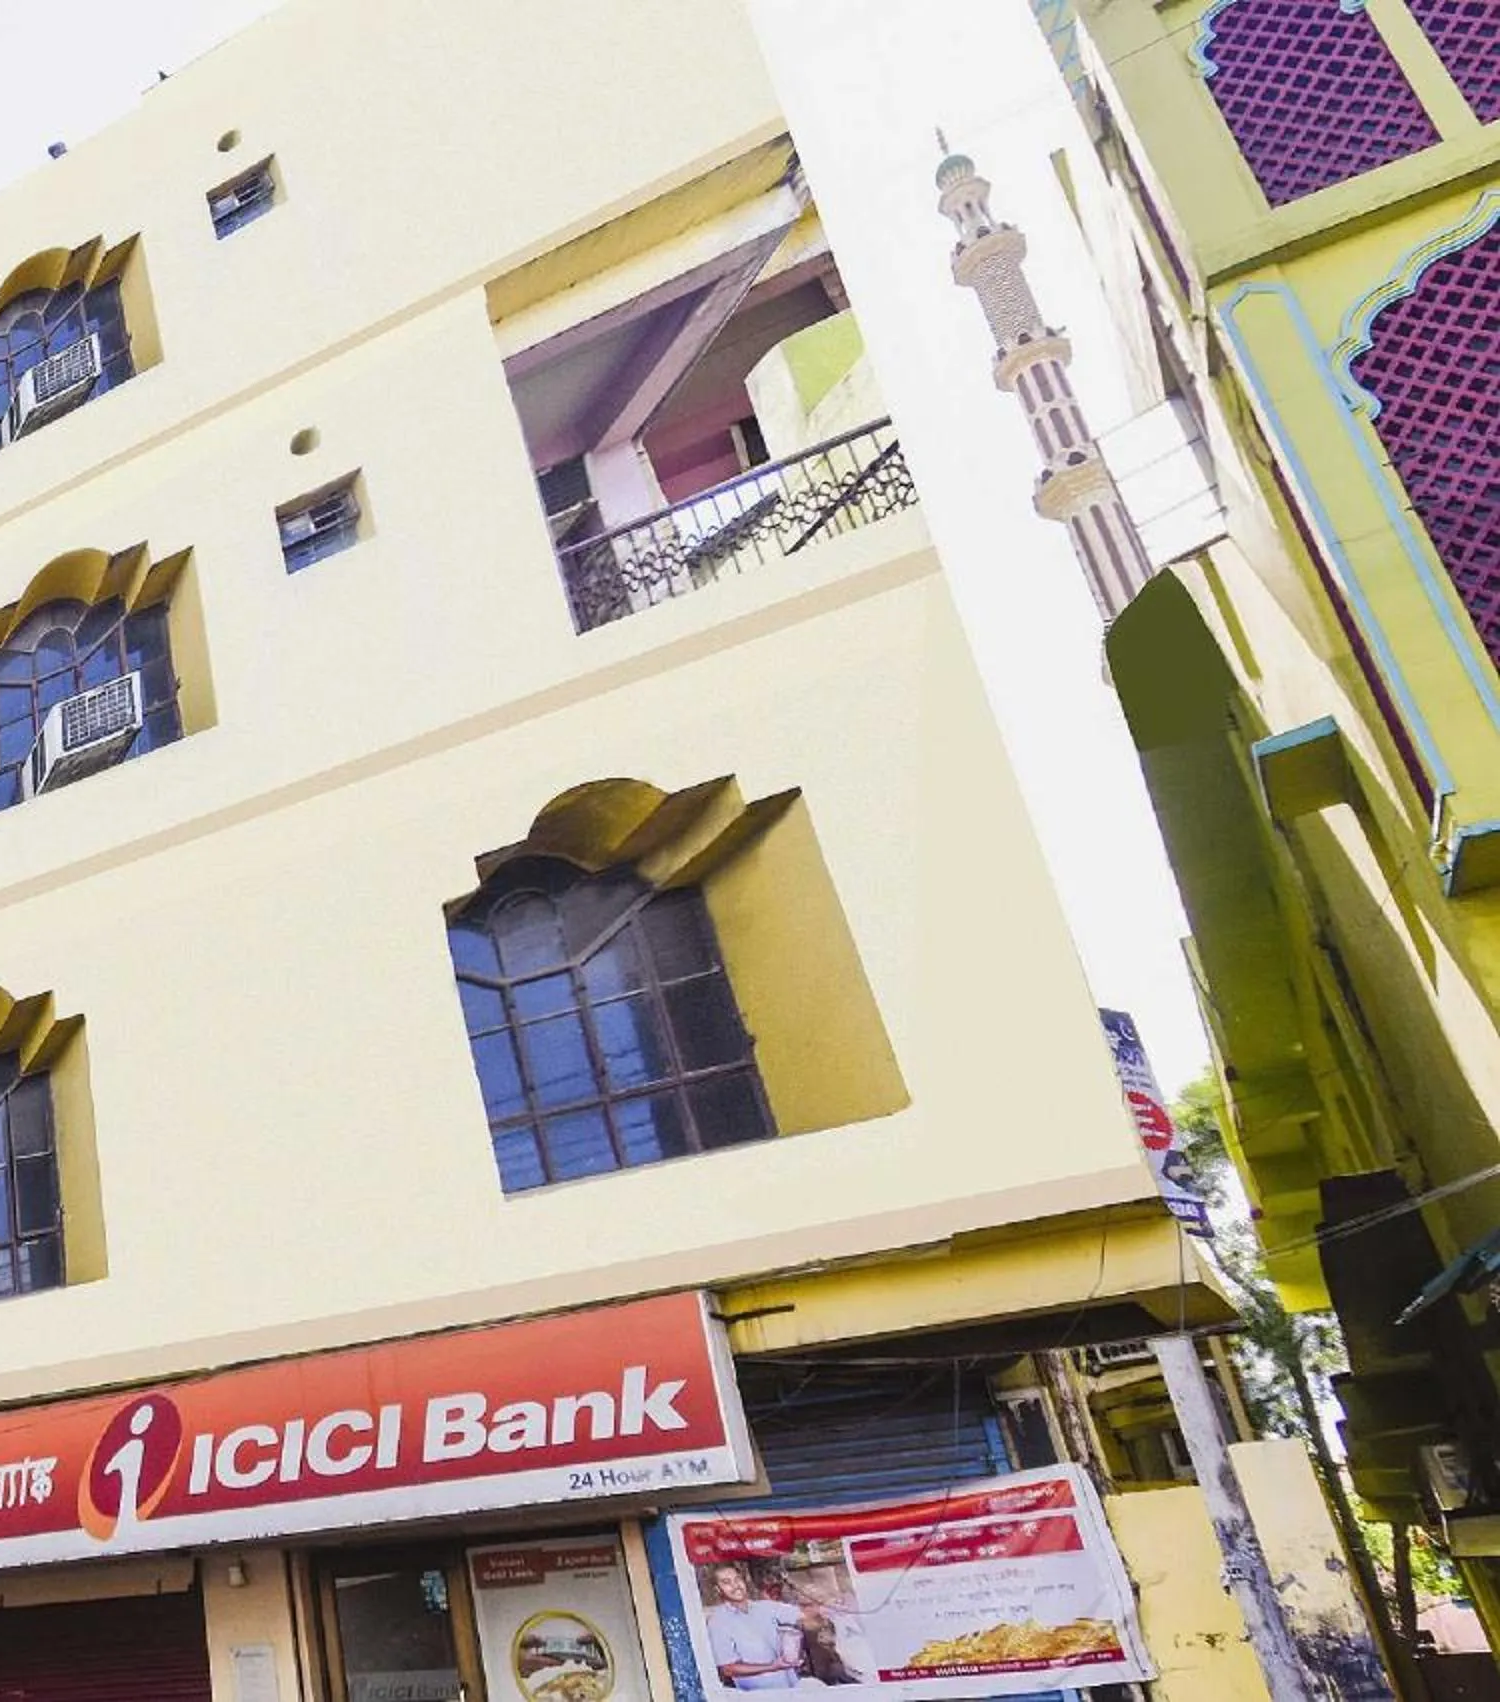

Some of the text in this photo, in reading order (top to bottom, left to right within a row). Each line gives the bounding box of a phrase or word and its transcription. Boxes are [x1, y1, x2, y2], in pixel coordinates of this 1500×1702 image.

[189, 1365, 688, 1495] ICICI Bank
[569, 1458, 708, 1491] 24 Hour ATM
